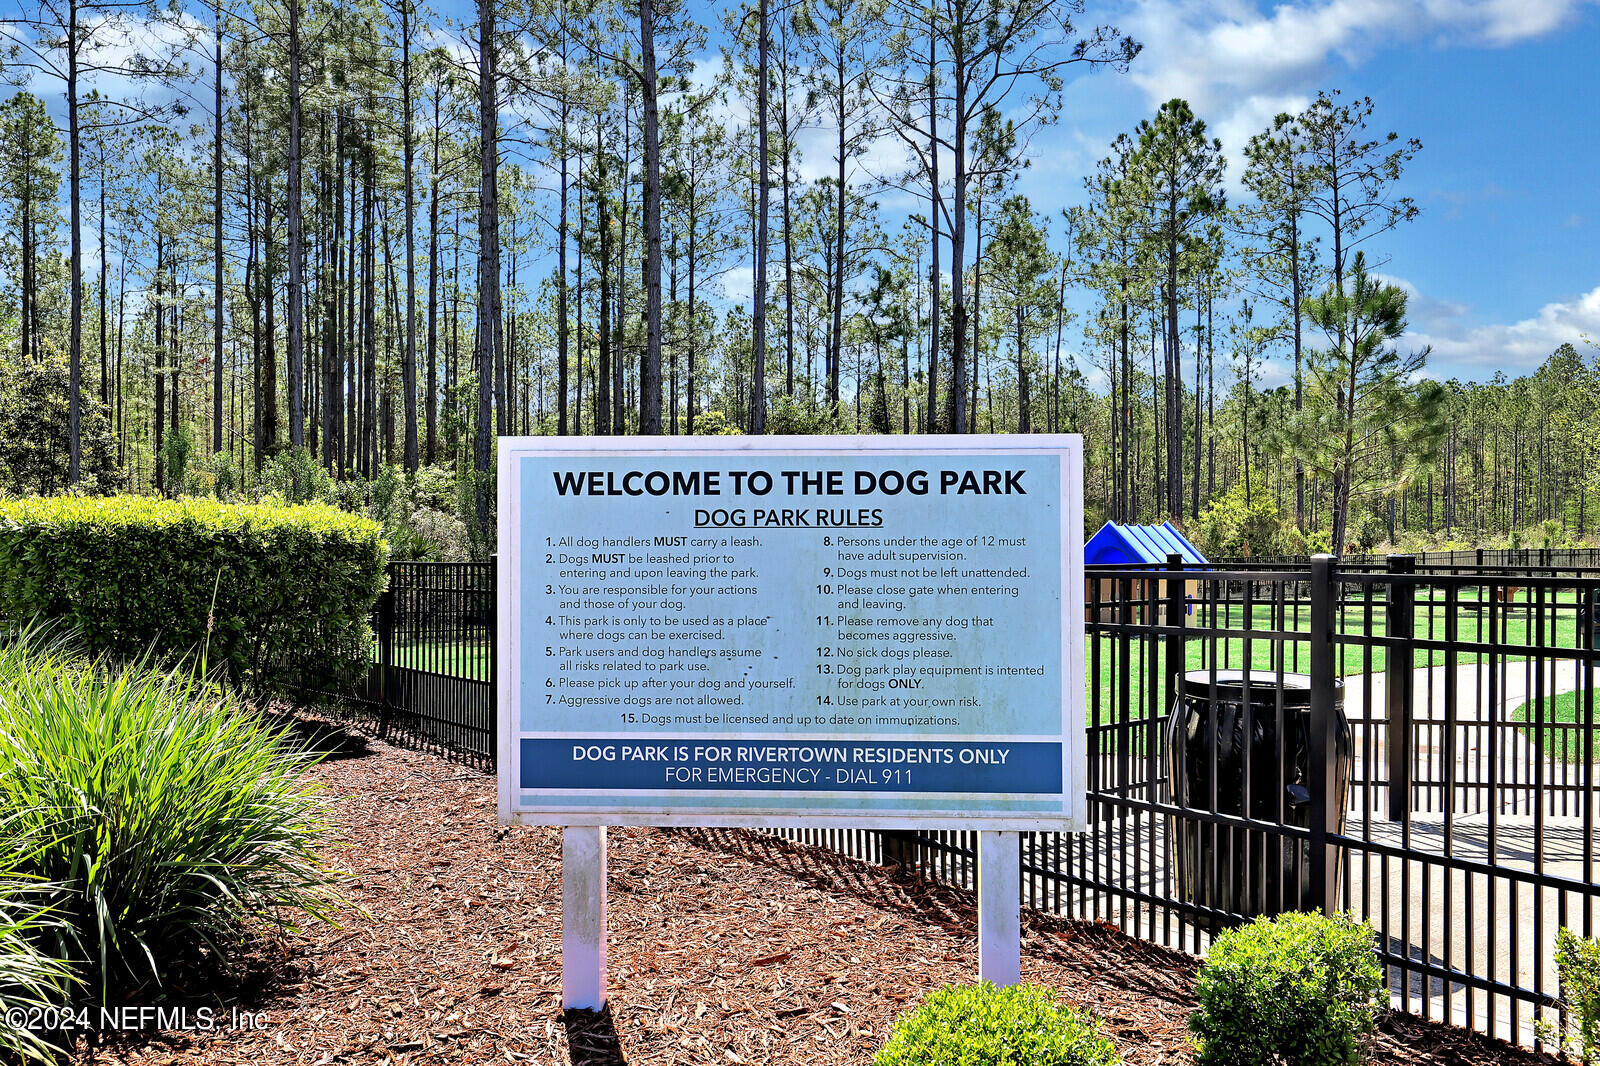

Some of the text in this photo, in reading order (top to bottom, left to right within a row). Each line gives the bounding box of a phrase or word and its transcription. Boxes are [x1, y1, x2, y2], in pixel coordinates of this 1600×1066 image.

[553, 470, 1027, 496] WELCOME TO THE DOG PARK
[695, 508, 883, 526] DOG PARK RULES
[546, 536, 556, 547] 1.
[558, 536, 573, 547] All
[576, 536, 599, 550] dog
[602, 536, 651, 547] handlers
[654, 536, 688, 547] MUST
[690, 539, 718, 550] carry
[730, 536, 762, 546] leash.
[823, 536, 1026, 548] 8. Persons under the age of 12 must
[546, 552, 734, 566] 2. Dogs MUST be leashed prior to
[838, 550, 966, 562] have adult supervision.
[560, 566, 759, 580] entering and upon leaving the park.
[823, 566, 1030, 580] 9. Dogs must not be left unattended.
[545, 584, 556, 595] 3.
[558, 584, 579, 595] You
[603, 584, 668, 598] responsible
[671, 584, 687, 595] for
[689, 587, 715, 598] your
[718, 584, 758, 595] actions
[816, 584, 1019, 598] 10. Please close gate when entering
[559, 598, 686, 612] and those of your dog.
[545, 616, 556, 626] 4.
[558, 616, 581, 626] This
[584, 615, 609, 628] park
[612, 616, 620, 626] is
[623, 614, 647, 628] only
[649, 617, 661, 626] to
[664, 615, 679, 626] be
[682, 614, 709, 626] used
[737, 616, 768, 628] place
[816, 615, 994, 628] 11. Please remove any dog that
[560, 629, 594, 640] where
[596, 628, 625, 642] dogs
[651, 628, 666, 640] be
[668, 628, 725, 640] exercised.
[816, 646, 953, 660] 12. No sick dogs please.
[816, 664, 1044, 678] 13. Dog park play equipment is intented
[545, 676, 796, 690] 6. Please pick up after your dog and yourself.
[838, 678, 924, 692] for dogs ONLY.
[545, 694, 556, 704] 7.
[558, 694, 620, 708] Aggressive
[623, 694, 652, 708] dogs
[676, 696, 694, 705] not
[697, 694, 744, 706] allowed.
[816, 695, 981, 710] 14. Use park at your own risk.
[621, 712, 639, 724] 15.
[642, 712, 672, 726] Dogs
[674, 715, 702, 724] must
[705, 712, 720, 724] be
[722, 712, 769, 724] licensed
[772, 714, 794, 724] and
[797, 716, 812, 727] up
[814, 716, 826, 724] to
[829, 713, 854, 725] date
[876, 714, 960, 726] immunizations.
[573, 746, 1010, 764] DOG PARK IS FOR RIVERTOWN RESIDENTS ONLY
[666, 766, 702, 782] FOR
[708, 767, 821, 784] EMERGENCY
[836, 768, 878, 784] DIAL
[882, 768, 912, 784] 911
